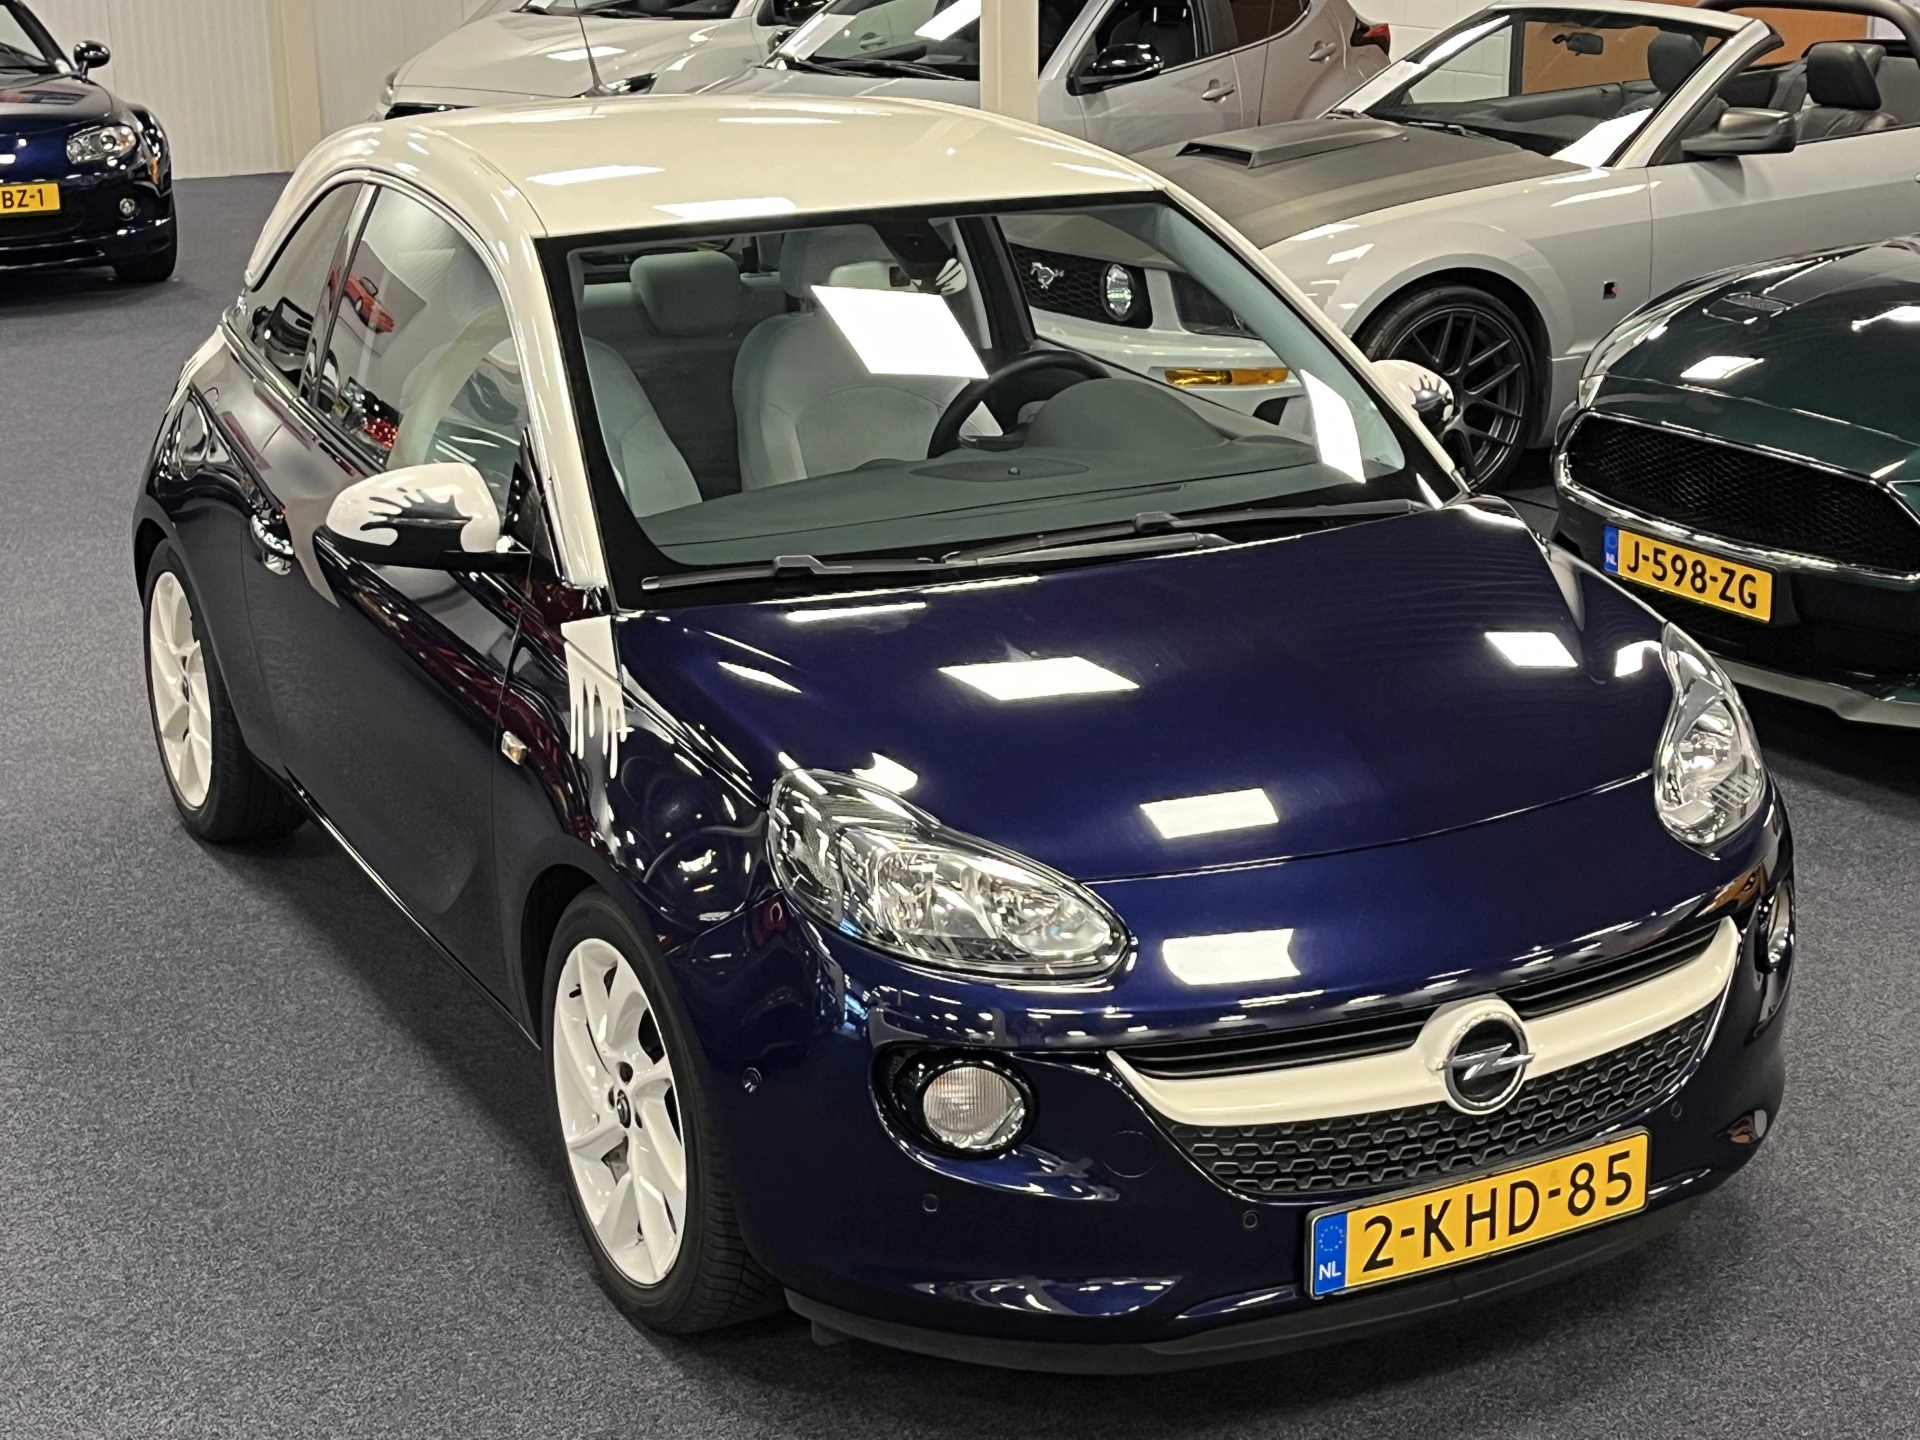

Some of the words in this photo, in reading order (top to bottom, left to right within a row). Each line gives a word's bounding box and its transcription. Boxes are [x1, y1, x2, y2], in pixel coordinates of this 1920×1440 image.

[1, 188, 44, 209] BZ-1
[1606, 552, 1617, 566] NL
[1627, 541, 1757, 610] J-598-ZG
[1362, 1150, 1632, 1273] 2-KHD-85
[1319, 1260, 1342, 1280] NL
